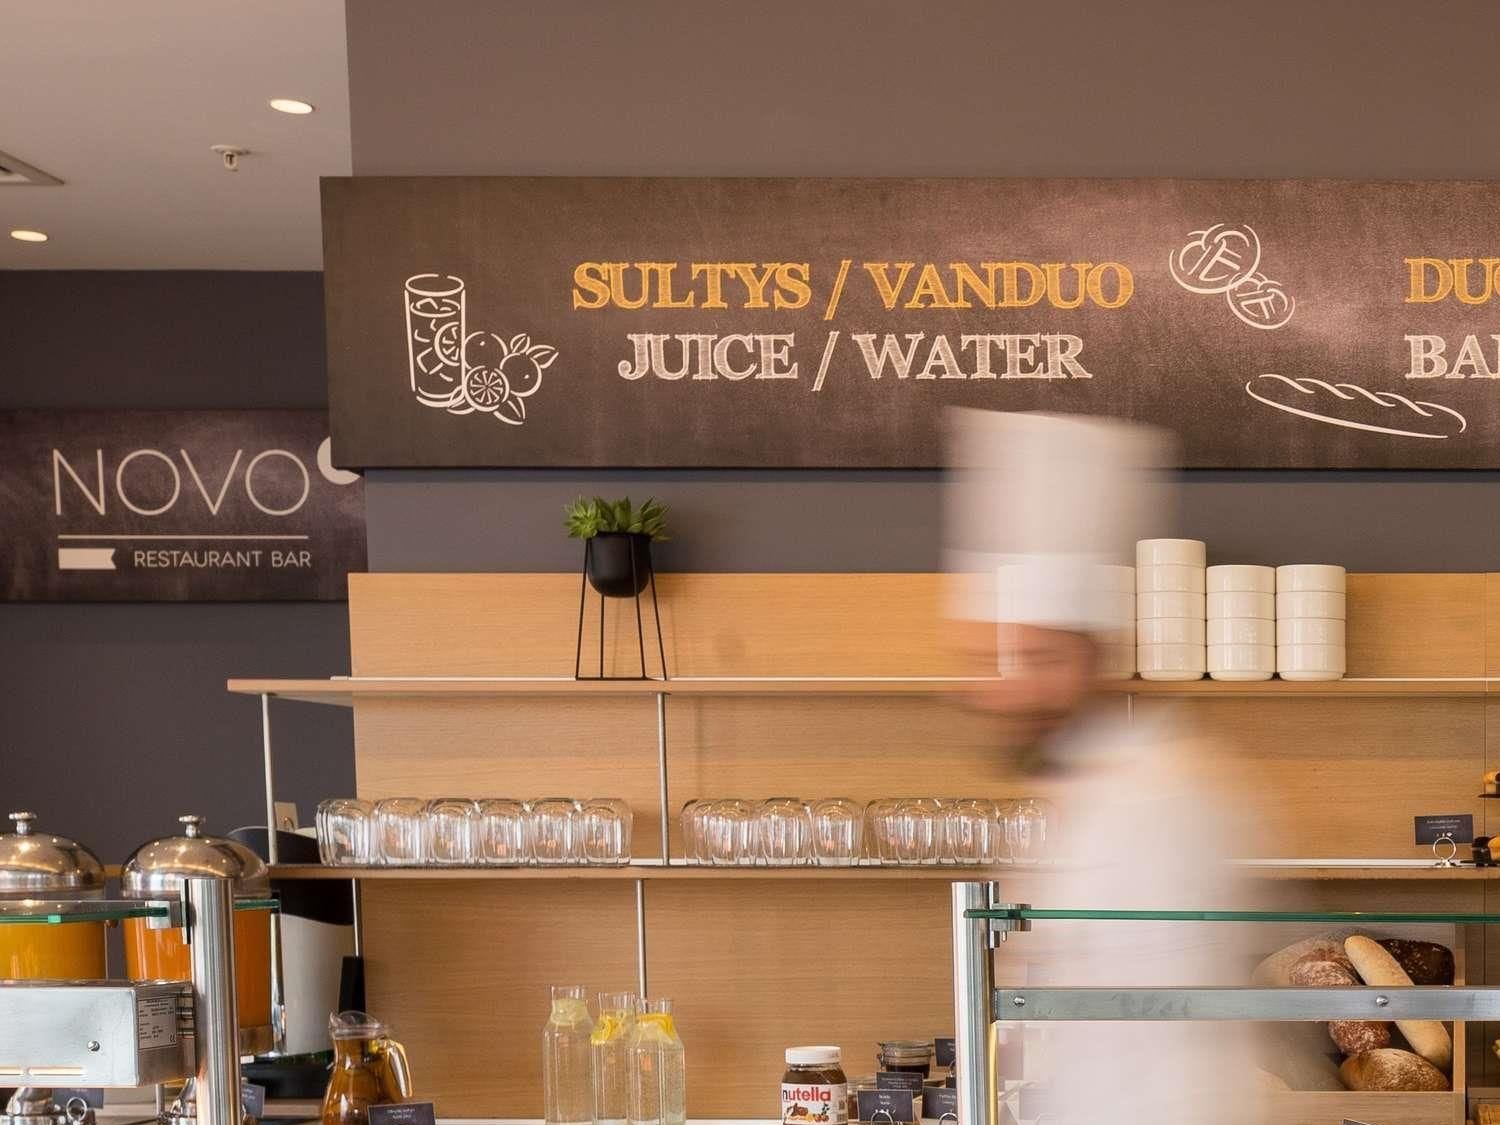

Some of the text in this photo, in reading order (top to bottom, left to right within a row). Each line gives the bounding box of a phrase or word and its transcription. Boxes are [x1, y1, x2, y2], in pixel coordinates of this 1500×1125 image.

[573, 259, 1135, 320] SULTYS / VANDUO
[618, 330, 1093, 391] JUICE / WATER
[53, 449, 311, 516] NOVO
[134, 550, 311, 568] RESTAURANT BAR
[783, 1086, 831, 1102] nutella
